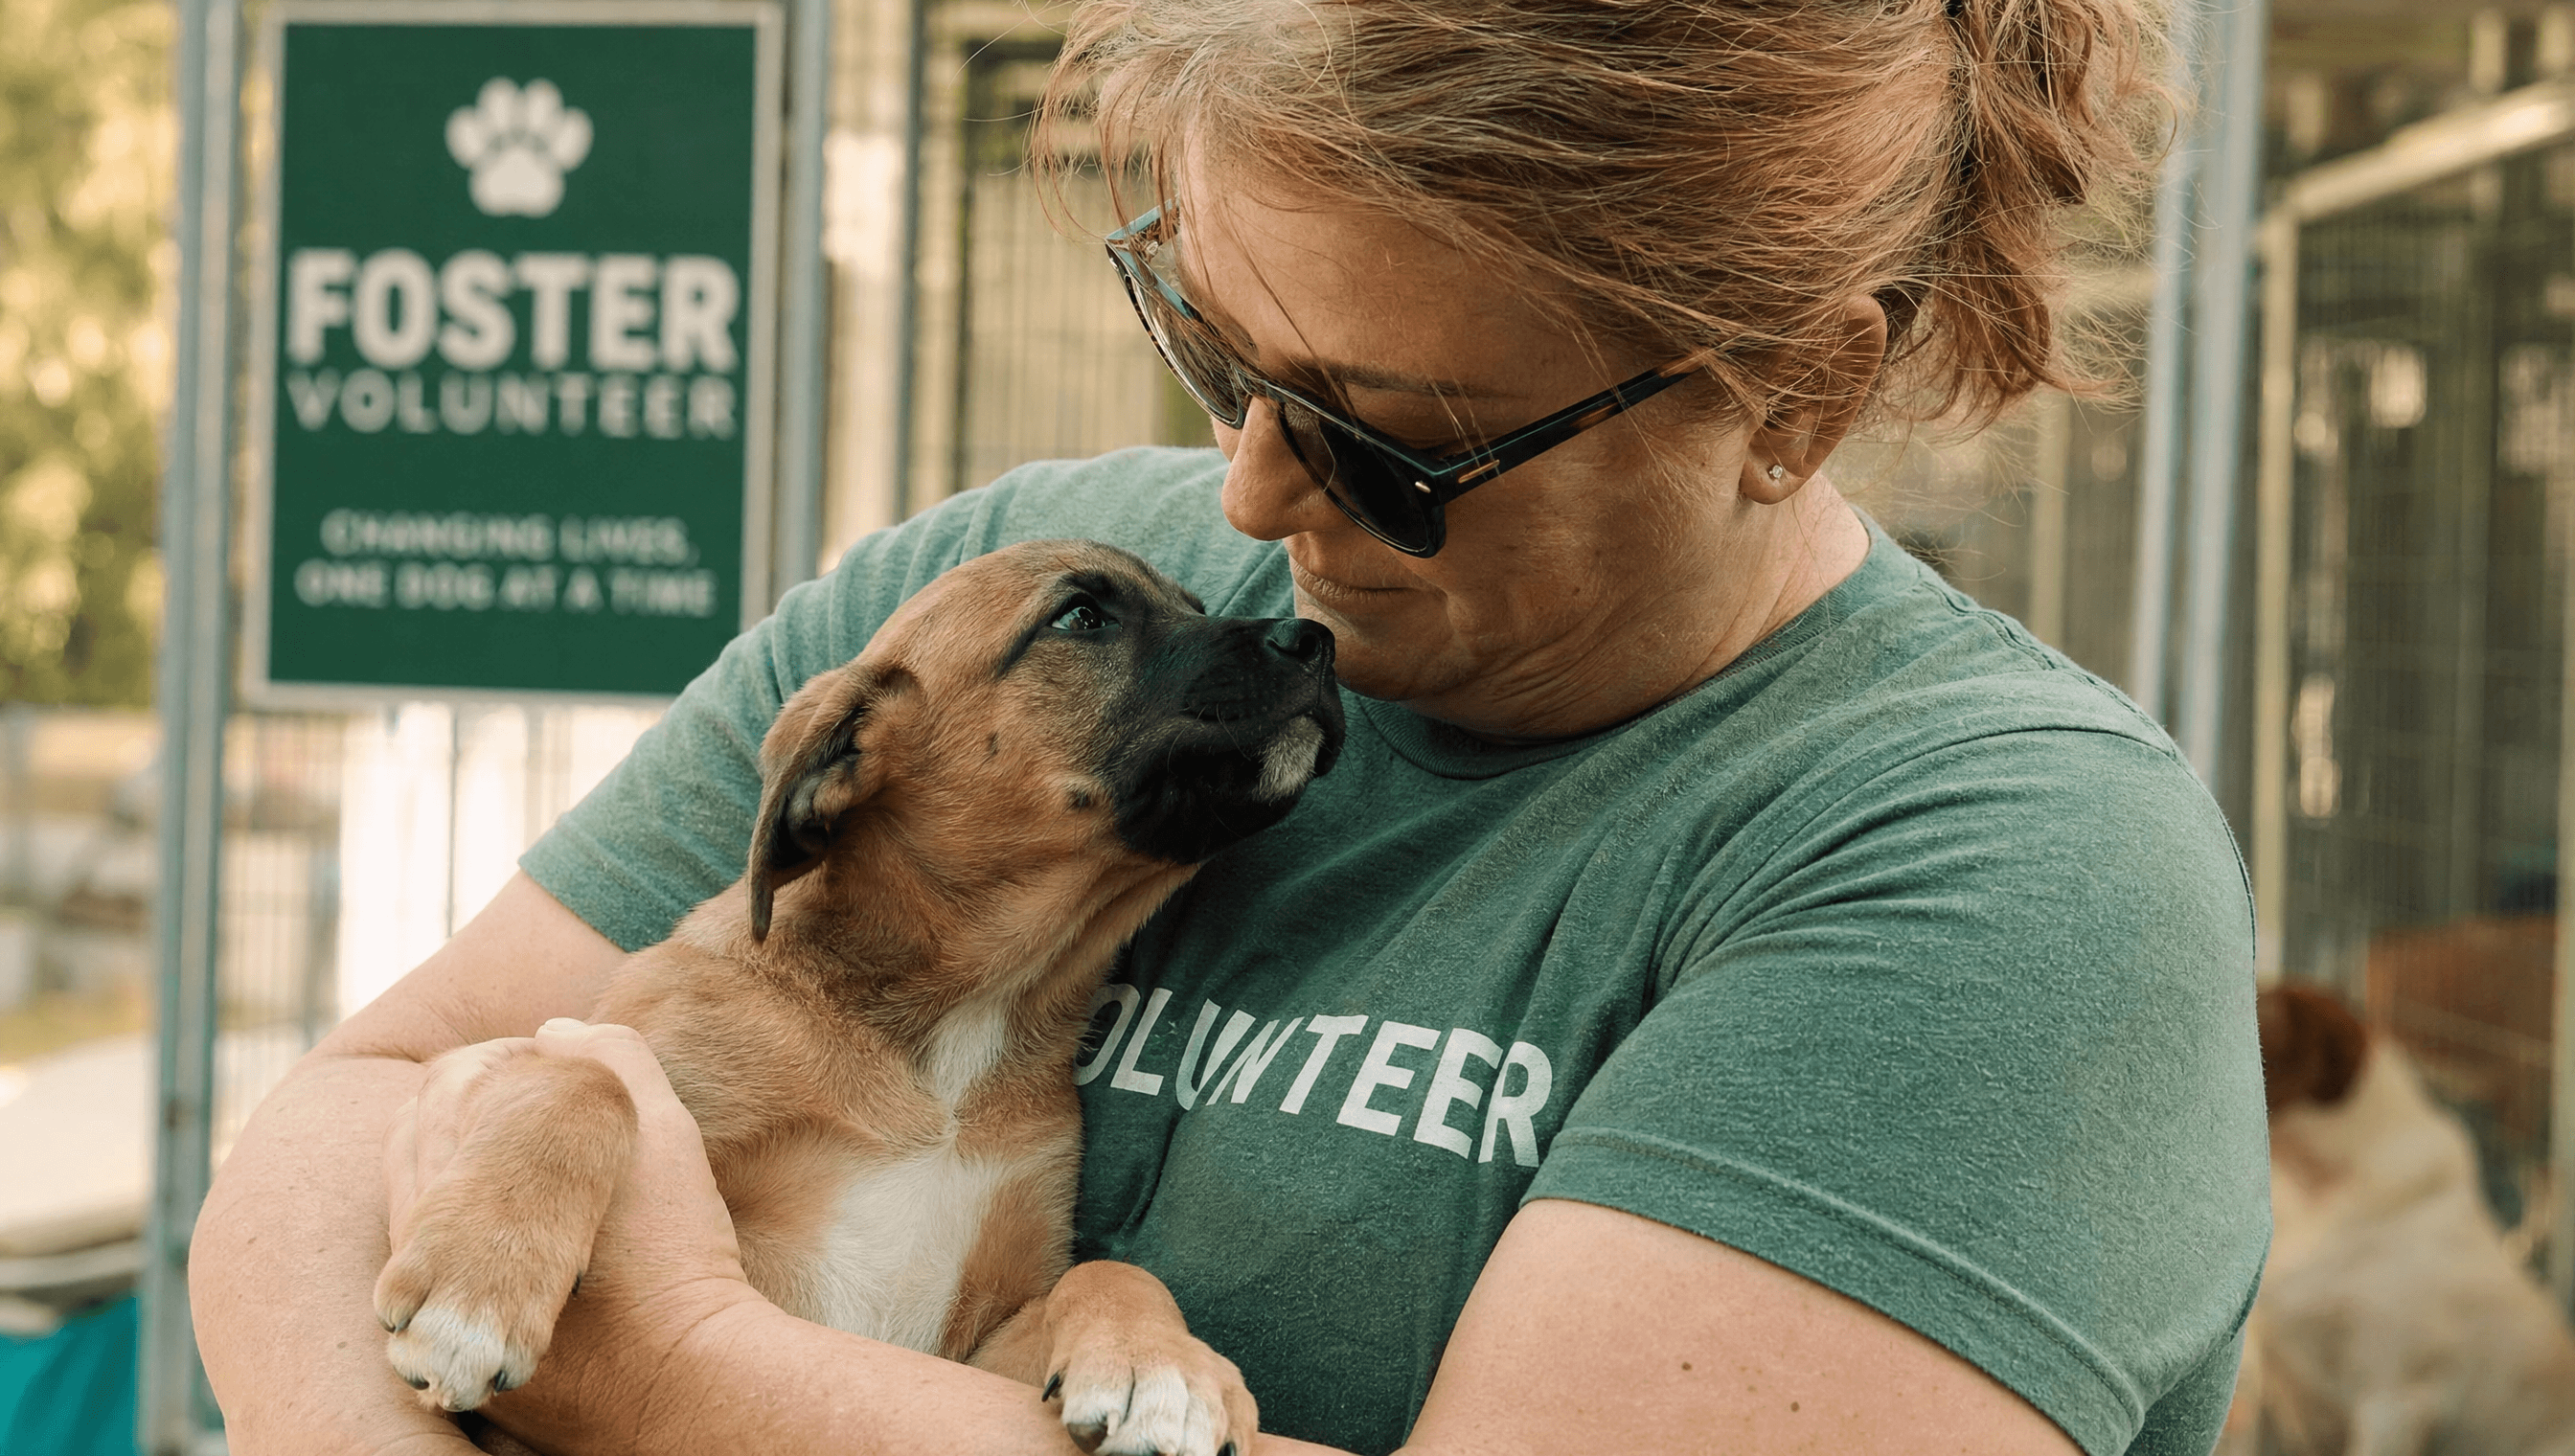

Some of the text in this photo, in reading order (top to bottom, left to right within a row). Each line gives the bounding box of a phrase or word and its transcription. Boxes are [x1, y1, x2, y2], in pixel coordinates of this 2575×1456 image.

[288, 248, 741, 373] FOSTER
[288, 370, 736, 439] VOLUNTEER
[321, 510, 700, 565] CHANGING LIVES,
[295, 558, 717, 617] ONE DOG AT A TIME
[1071, 983, 1553, 1168] OLUNTEER
